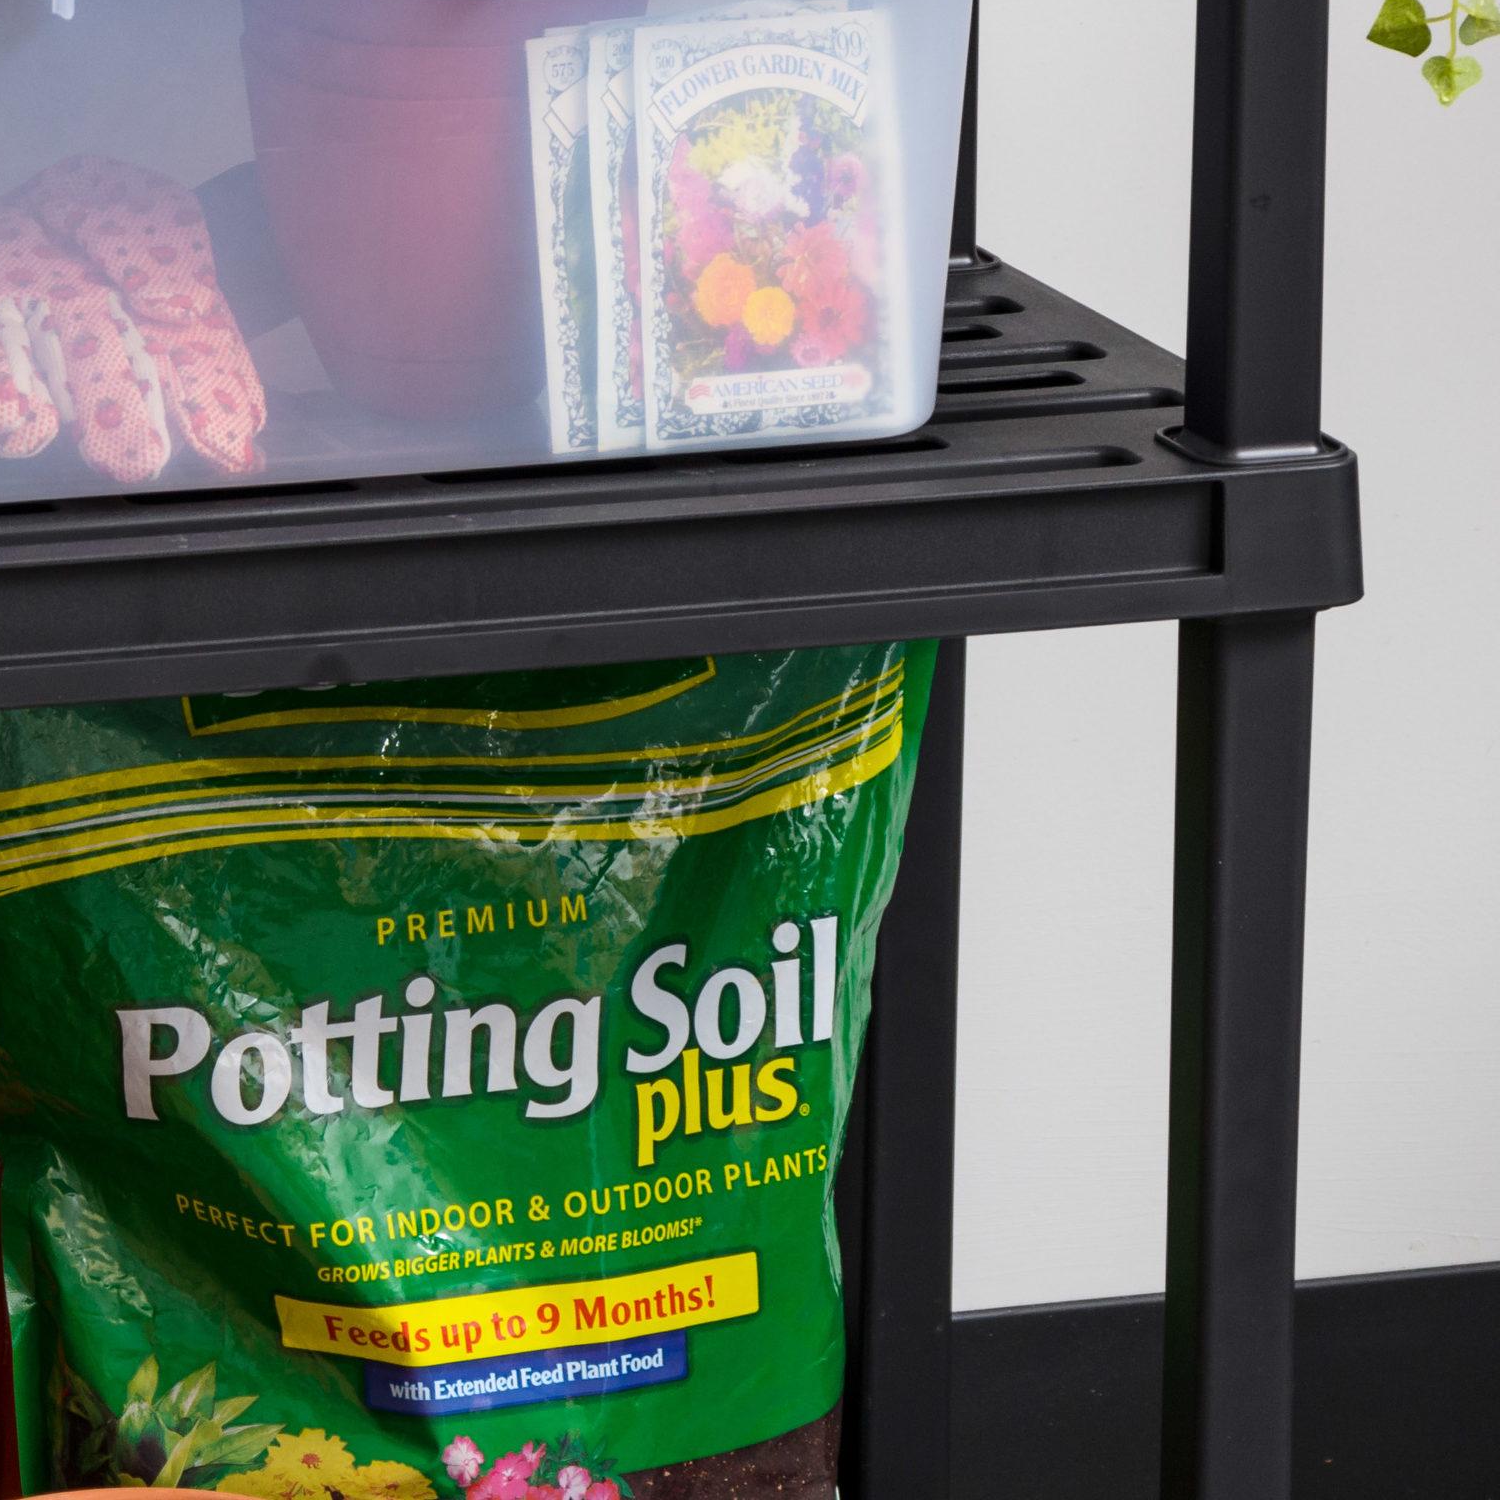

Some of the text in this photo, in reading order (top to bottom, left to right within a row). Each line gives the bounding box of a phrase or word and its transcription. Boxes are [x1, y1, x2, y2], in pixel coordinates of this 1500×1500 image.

[660, 54, 865, 117] FLOWER GARDEN MIX
[714, 373, 843, 398] AMERICAN SEED
[376, 894, 589, 946] PREMIUM
[115, 915, 838, 1126] Potting Soil
[175, 1144, 828, 1250] PERFECT FOR INDOOR & OUTDOOR PLANTS
[317, 1260, 391, 1285] GROWS
[393, 1251, 461, 1278] BIGGER
[464, 1243, 536, 1269] PLANTS
[540, 1239, 556, 1259] &
[560, 1232, 618, 1256] MORE
[324, 1274, 717, 1354] Feeds up to 9 Months!
[389, 1348, 664, 1403] with Extended Feed Plant Food
